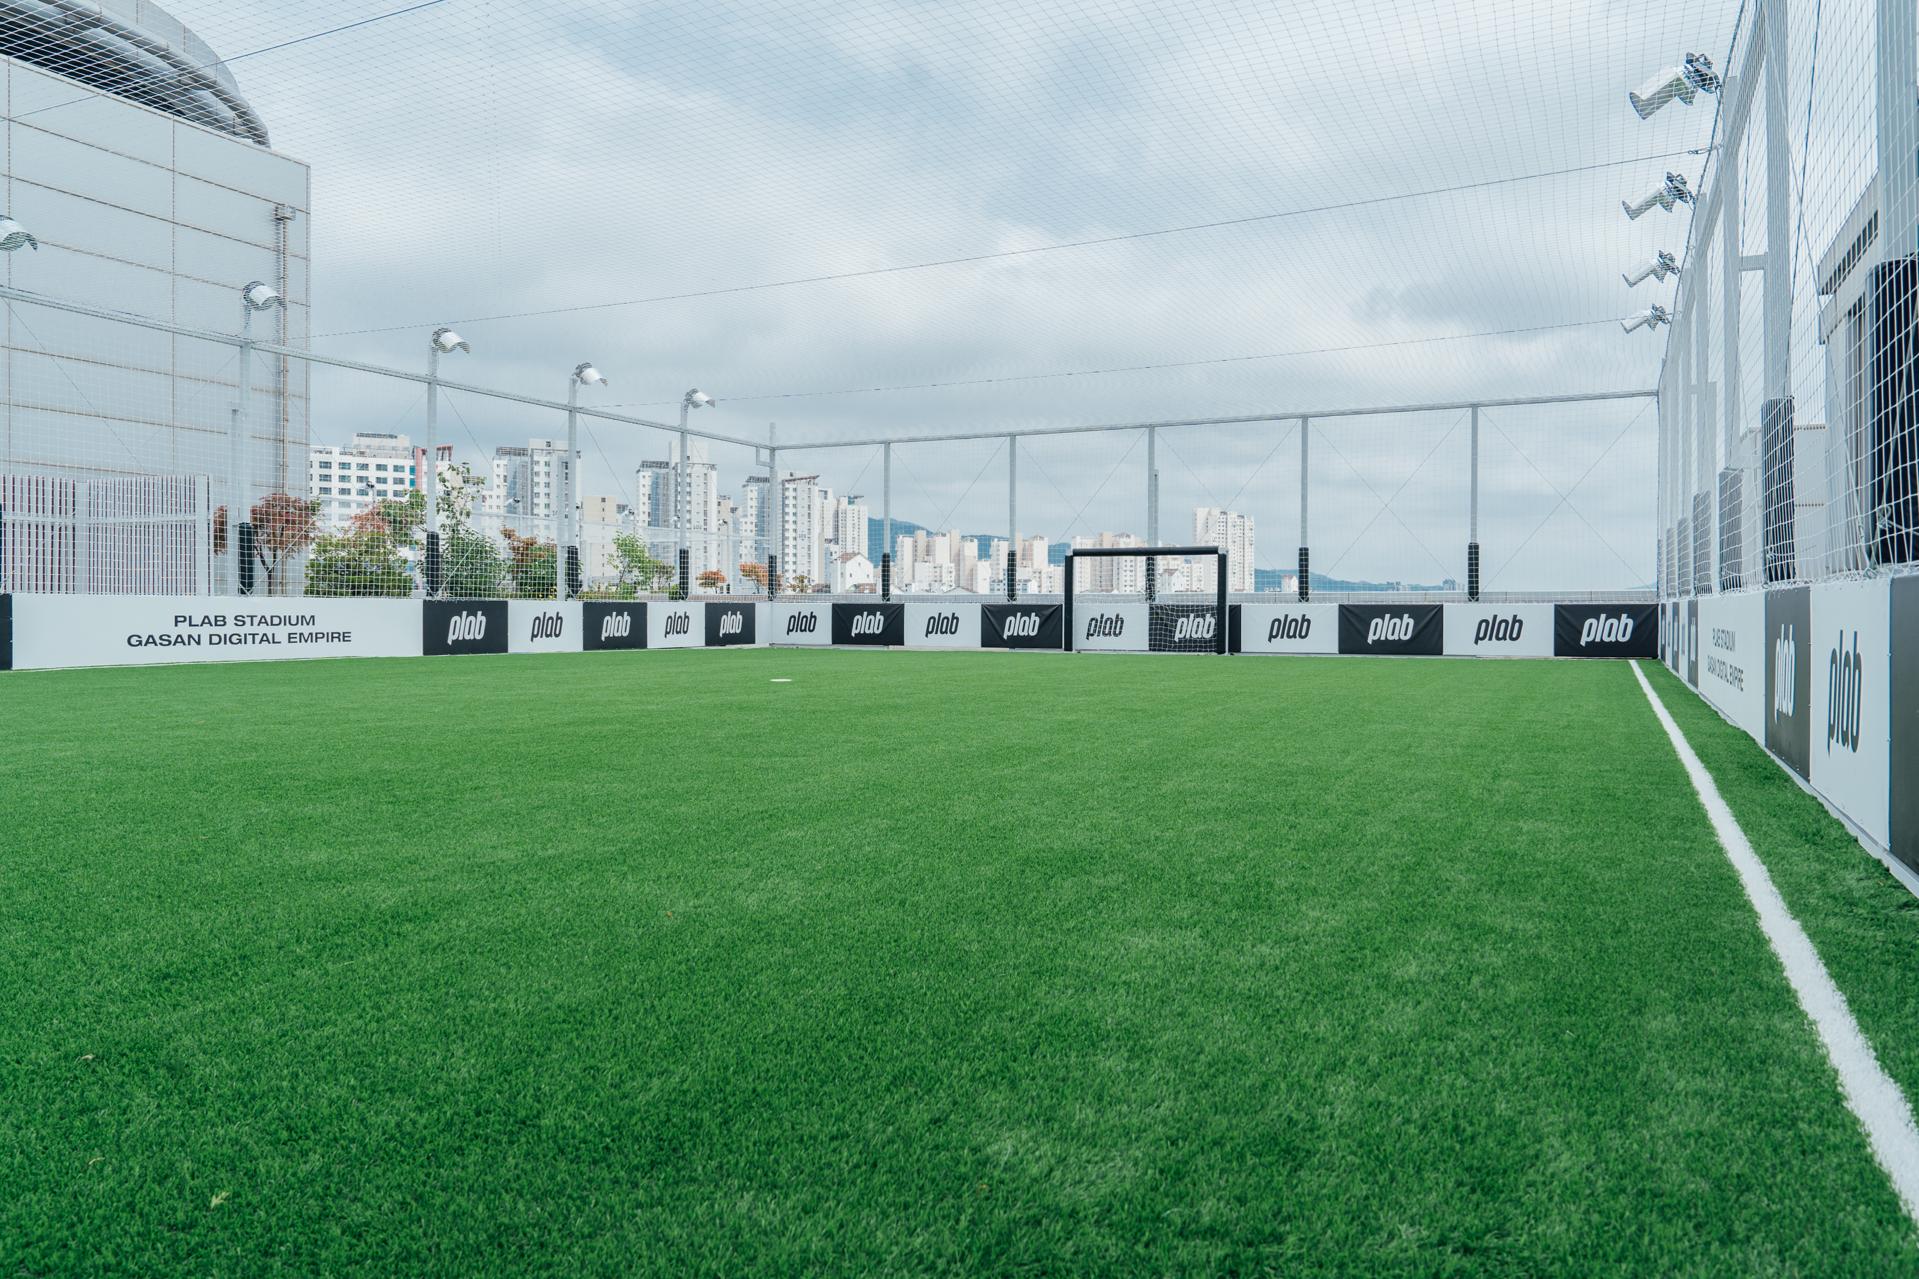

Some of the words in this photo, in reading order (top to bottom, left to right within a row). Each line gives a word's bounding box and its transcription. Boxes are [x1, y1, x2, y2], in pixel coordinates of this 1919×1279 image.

[174, 615, 227, 628] PLAB
[233, 614, 316, 627] STADIUM
[447, 610, 487, 645] plab
[530, 611, 564, 643] plab
[601, 611, 632, 642] plab
[664, 611, 690, 638] plab
[719, 611, 743, 637] plab
[786, 611, 818, 638] plab
[851, 611, 885, 638] plab
[924, 612, 960, 638] plab
[1003, 612, 1041, 641] plab
[1085, 613, 1125, 641] plab
[1174, 613, 1216, 643] plab
[1267, 613, 1312, 644] plab
[1367, 613, 1415, 645] plab
[1473, 614, 1524, 646] plab
[1579, 613, 1634, 647] plab
[126, 633, 201, 648] GASAN
[208, 632, 282, 646] DIGITAL
[287, 631, 352, 644] EMPIRE
[1774, 623, 1796, 724] plab
[1827, 629, 1862, 758] plab
